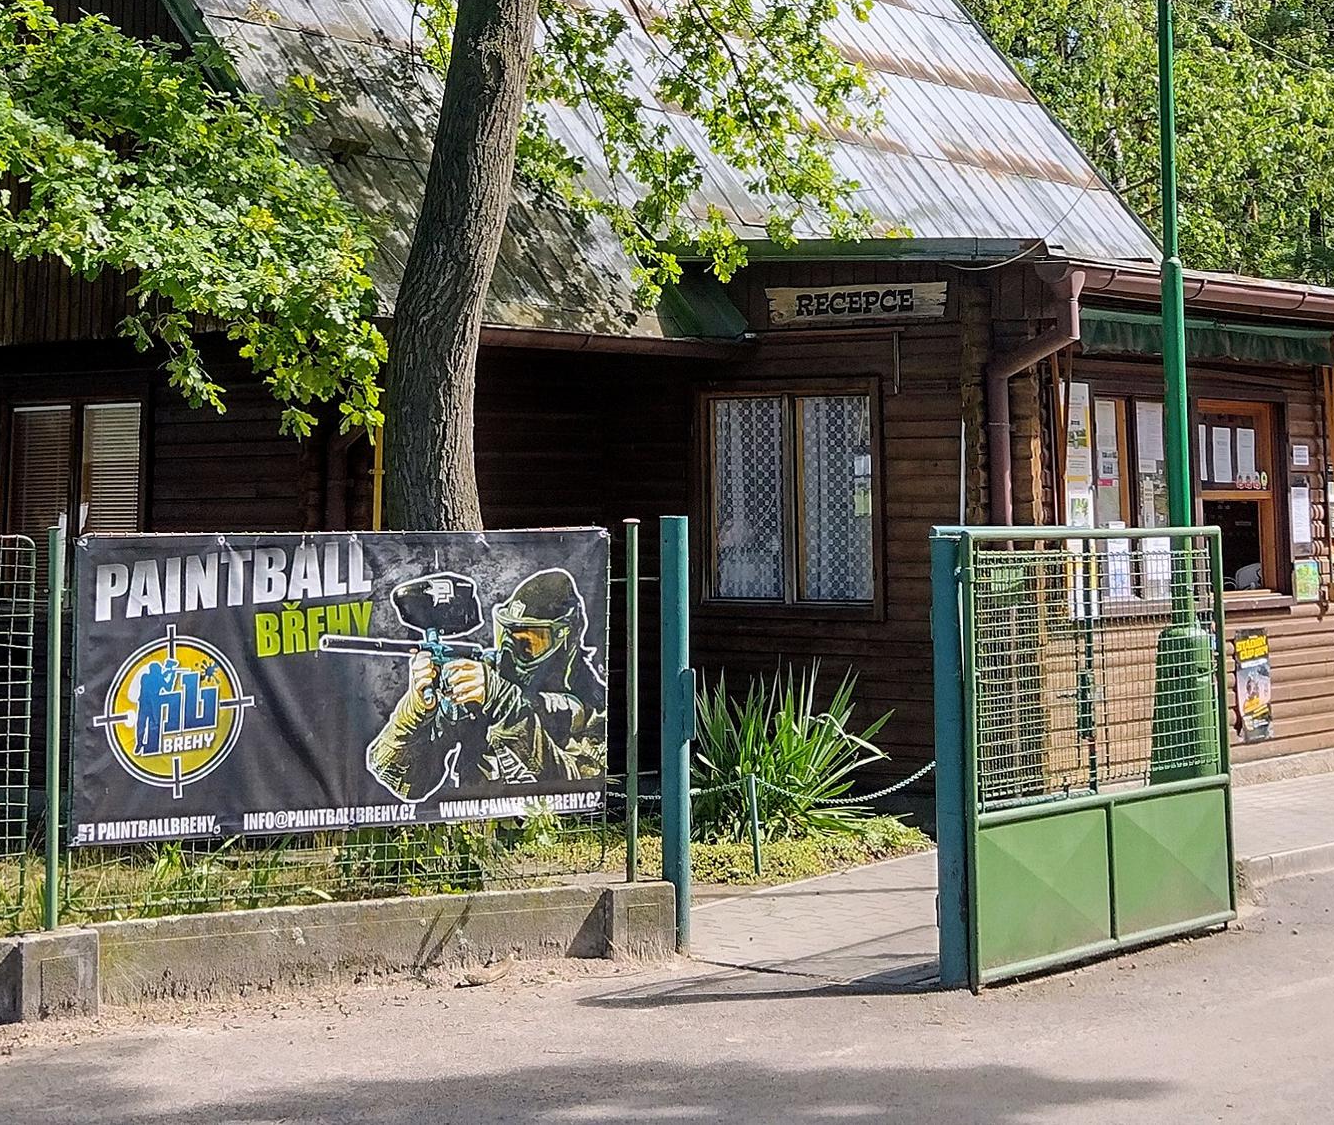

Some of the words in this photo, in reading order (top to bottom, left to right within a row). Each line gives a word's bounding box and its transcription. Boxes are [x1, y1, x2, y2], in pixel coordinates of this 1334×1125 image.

[795, 289, 914, 317] RECEPCE
[95, 541, 373, 623] PAINTBALL
[255, 601, 374, 658] BŘEHY
[97, 816, 216, 841] PAINTBALLBREHY
